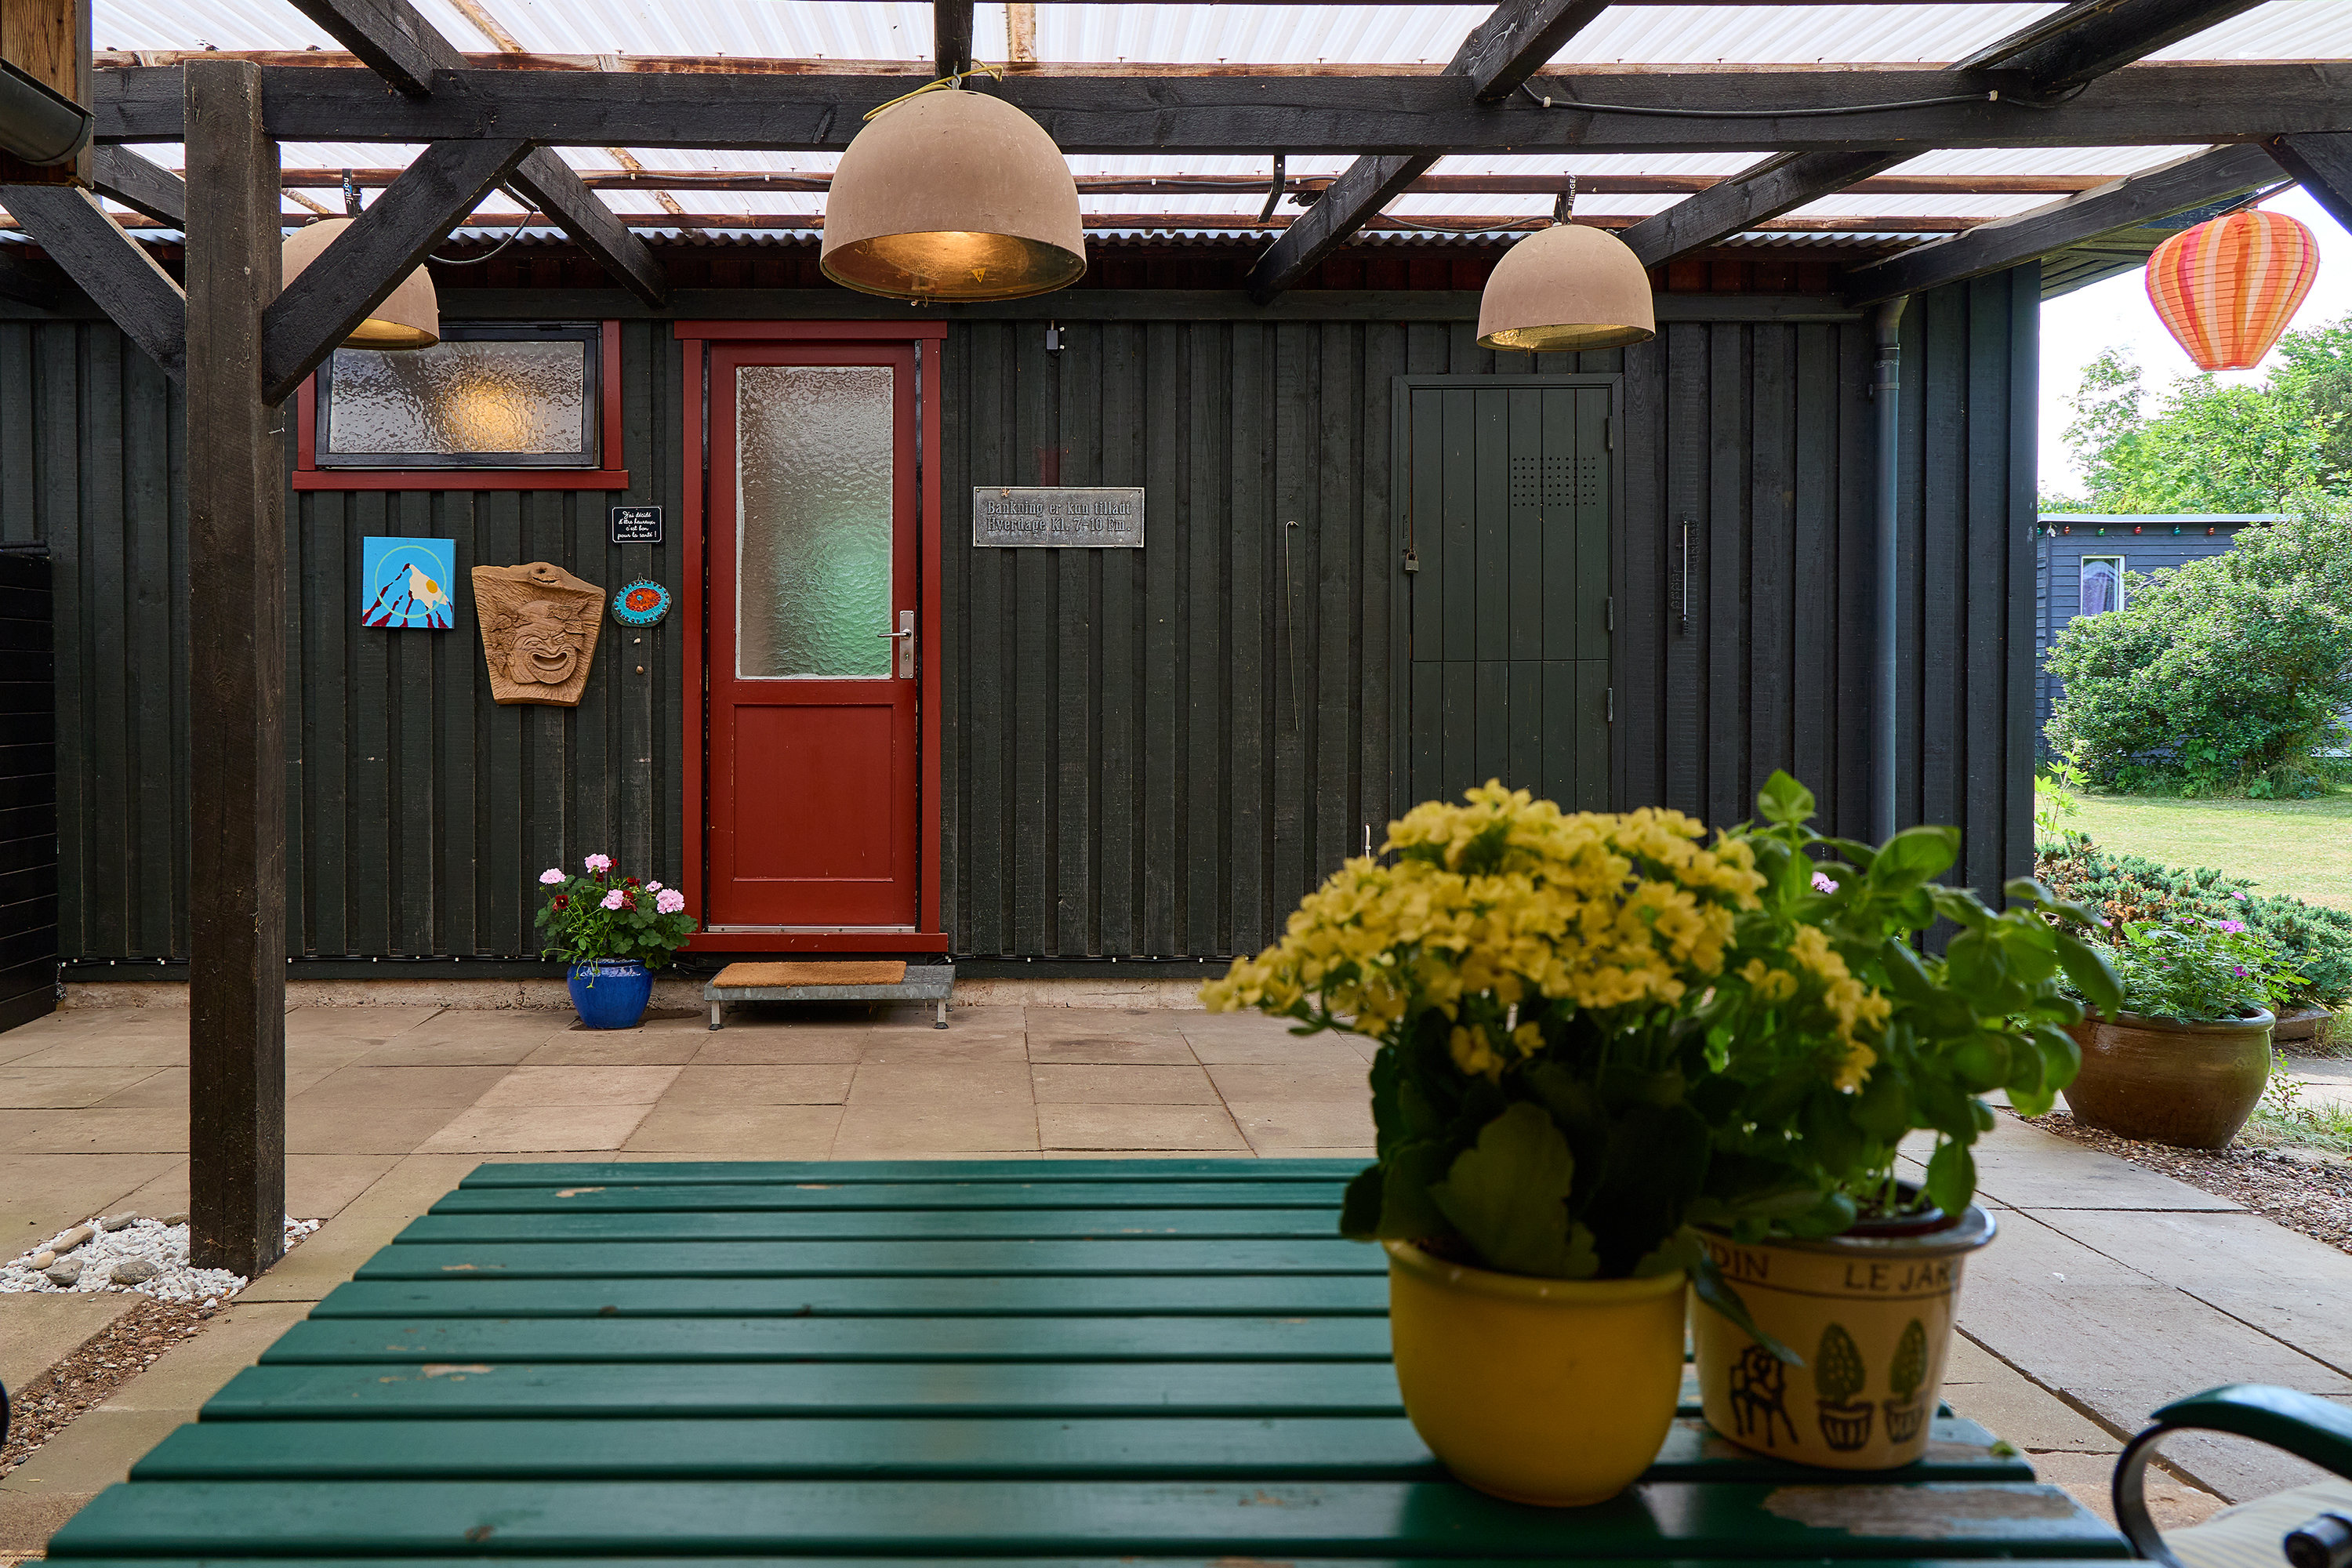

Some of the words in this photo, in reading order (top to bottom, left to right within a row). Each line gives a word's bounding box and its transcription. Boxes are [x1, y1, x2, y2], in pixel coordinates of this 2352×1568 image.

[343, 177, 354, 205] nordic
[622, 510, 634, 520] J'ai
[987, 501, 1044, 517] Bankning
[1049, 503, 1062, 515] er
[1067, 501, 1090, 515] kun
[1094, 501, 1131, 515] tilladt
[986, 517, 1046, 533] Hverdage
[1051, 517, 1069, 532] Kl.
[1073, 517, 1103, 532] 7-10
[1107, 517, 1131, 532] Fm.
[1844, 1263, 1890, 1292] LE
